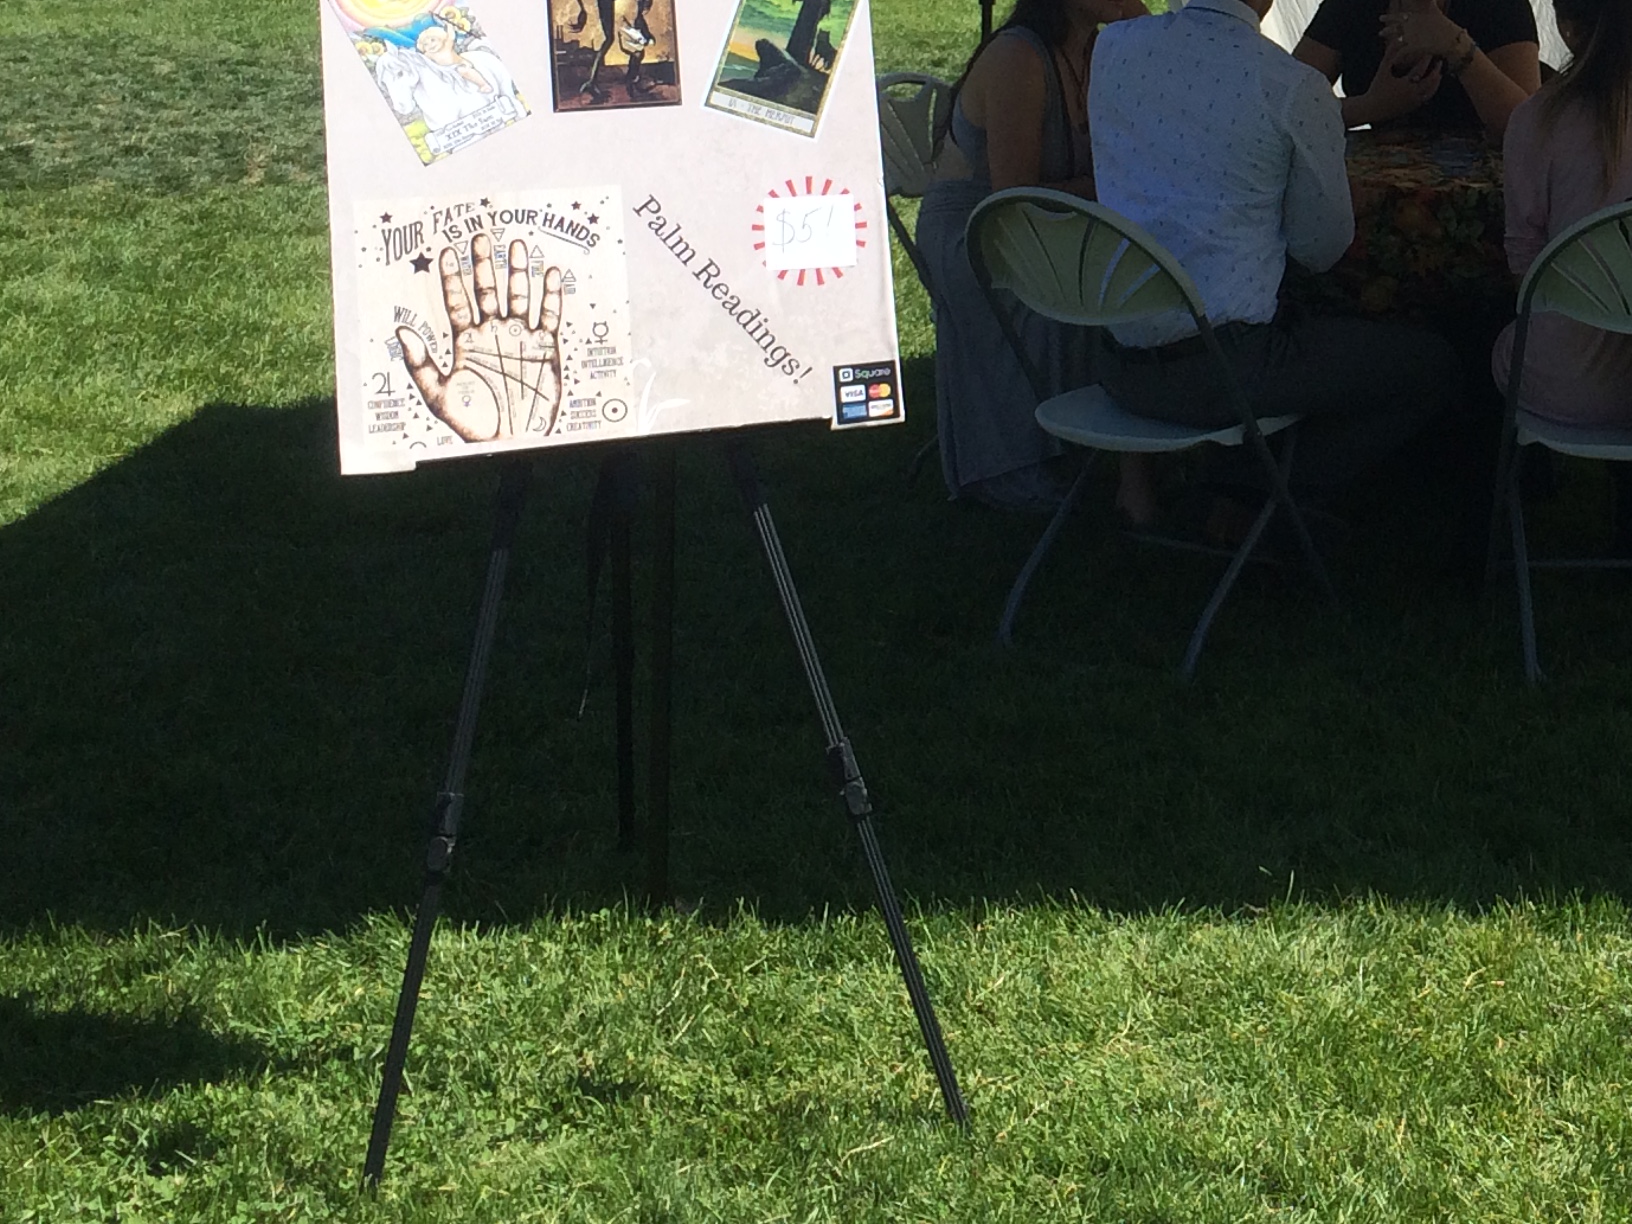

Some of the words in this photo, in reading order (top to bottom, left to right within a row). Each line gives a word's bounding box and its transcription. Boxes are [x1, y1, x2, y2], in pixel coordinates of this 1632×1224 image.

[381, 220, 425, 266] YOUR
[433, 203, 475, 235] FATE
[442, 225, 463, 243] IS
[464, 214, 484, 233] IN
[487, 209, 537, 226] YOUR
[542, 212, 601, 248] HANDS
[632, 193, 697, 267] Palm
[692, 257, 813, 385] Readings!
[394, 305, 417, 327] WILL
[854, 367, 892, 380] Square
[845, 389, 863, 398] VISA
